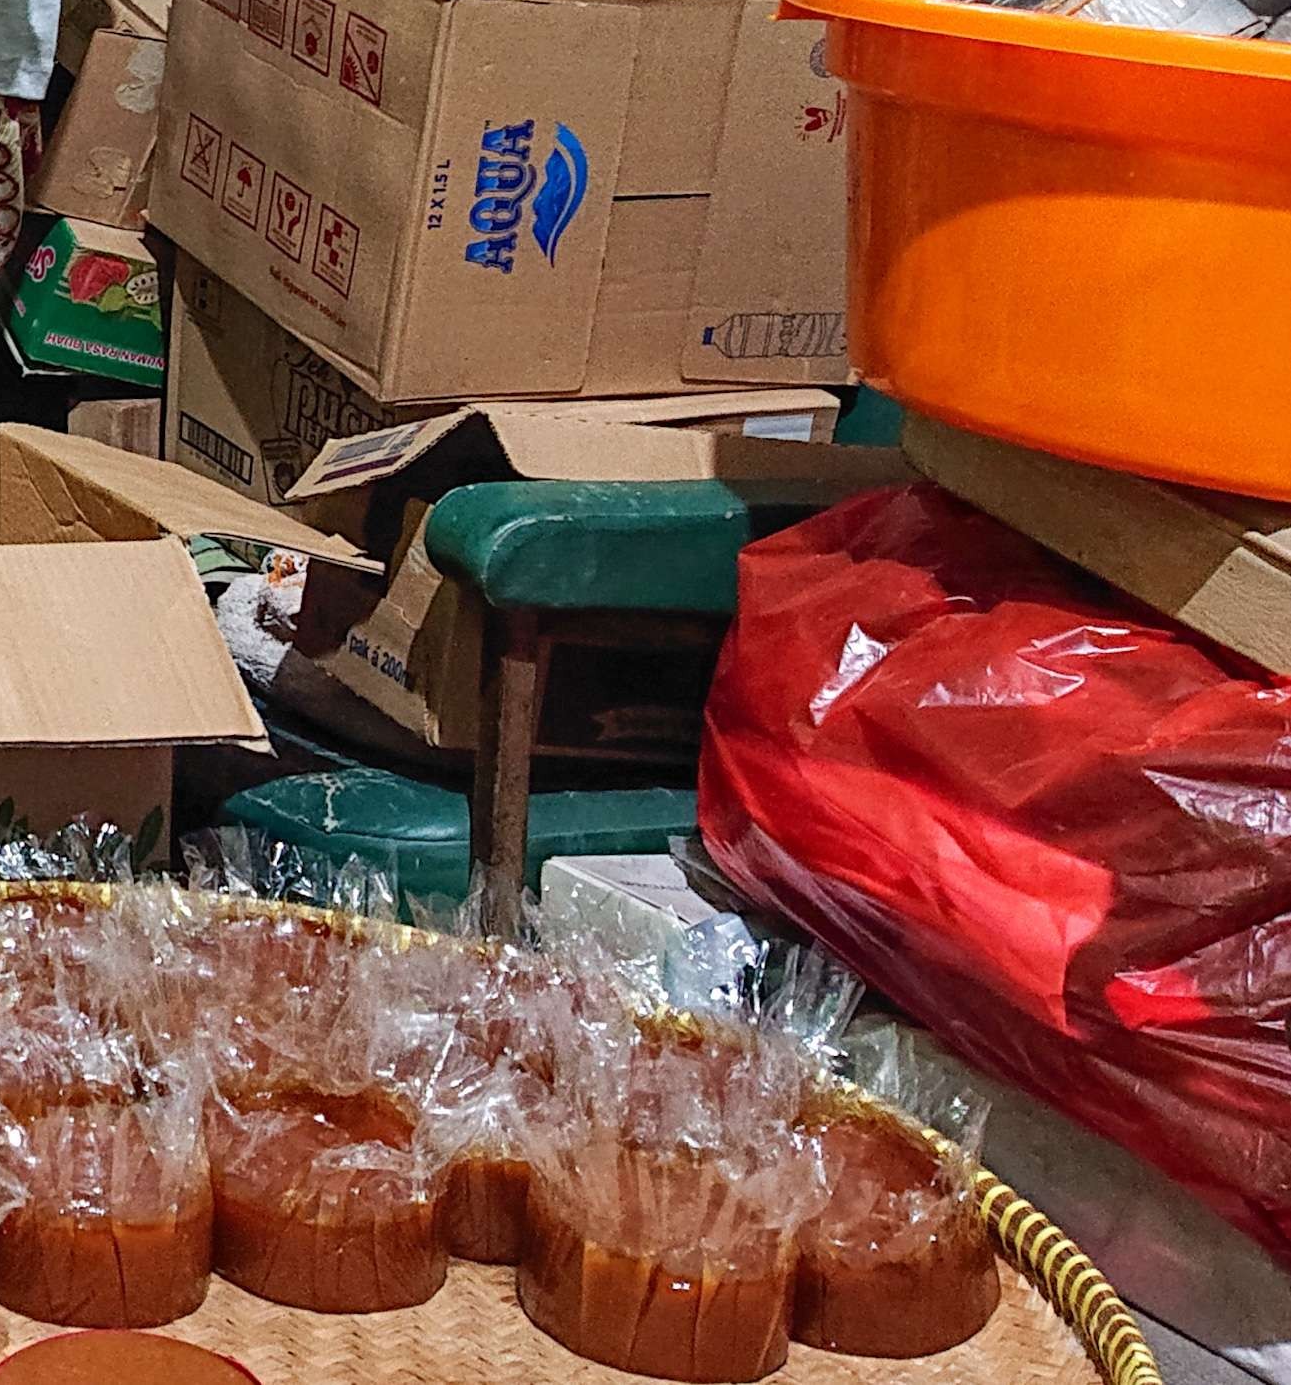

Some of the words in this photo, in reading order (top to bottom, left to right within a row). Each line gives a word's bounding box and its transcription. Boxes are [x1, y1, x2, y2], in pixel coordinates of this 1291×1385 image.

[437, 159, 450, 169] L
[433, 173, 448, 194] 1.5
[465, 119, 538, 274] AQUA
[428, 214, 443, 230] 12
[44, 332, 83, 351] BUAH
[83, 340, 117, 361] RASA
[350, 636, 369, 659] pak
